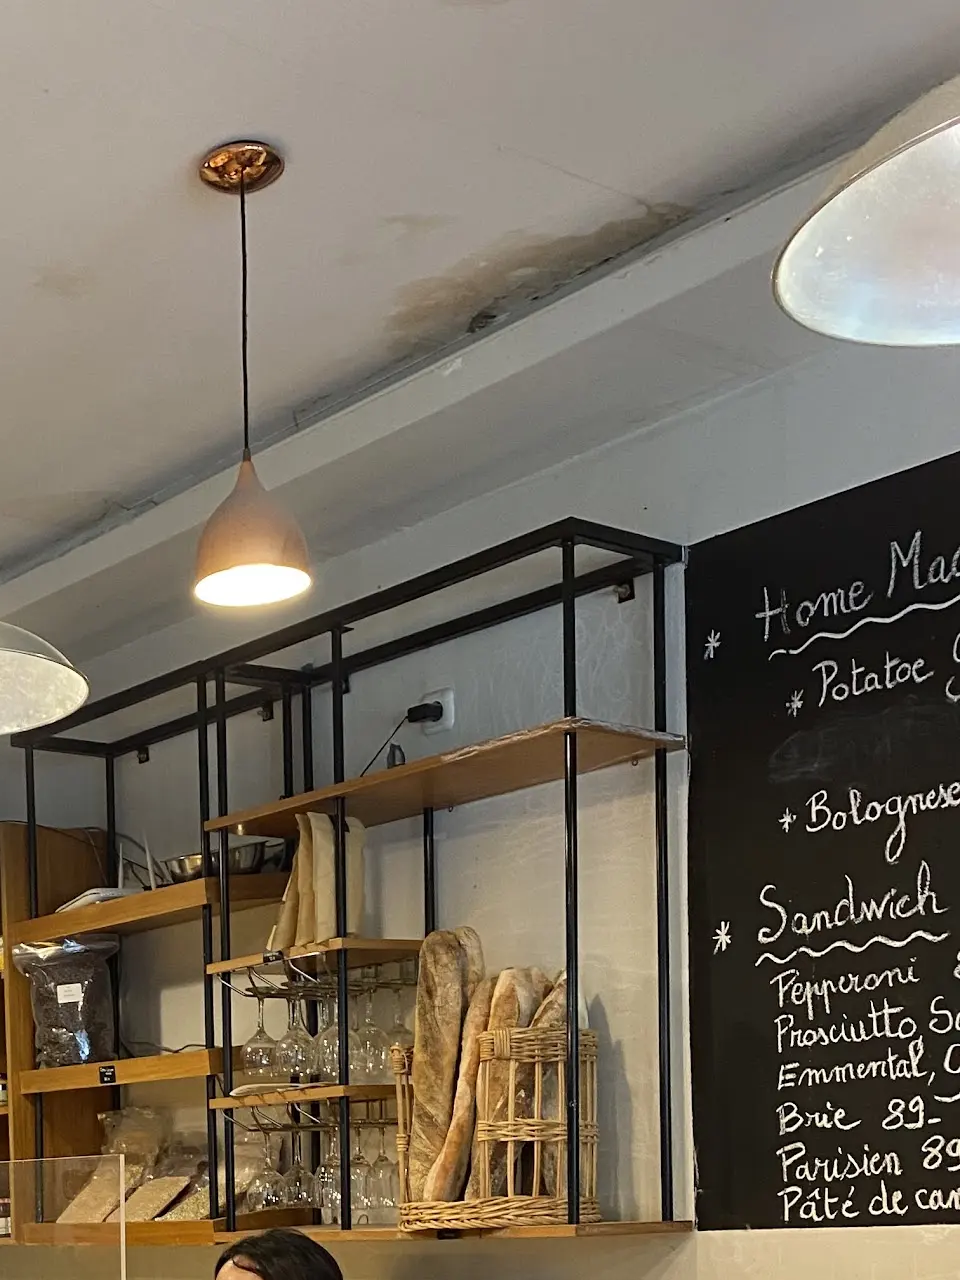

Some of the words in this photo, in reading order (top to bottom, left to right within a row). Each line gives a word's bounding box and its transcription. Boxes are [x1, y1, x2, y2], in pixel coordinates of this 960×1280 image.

[755, 580, 875, 642] Home
[812, 650, 935, 707] Potatoe
[756, 860, 951, 944] Sandwich
[770, 956, 921, 1020] Pepperoni
[777, 1038, 937, 1090] Emmental,
[777, 1101, 862, 1136] Brie
[776, 1141, 903, 1183] Parisien
[778, 1182, 860, 1222] Pâté
[868, 1179, 909, 1216] de
